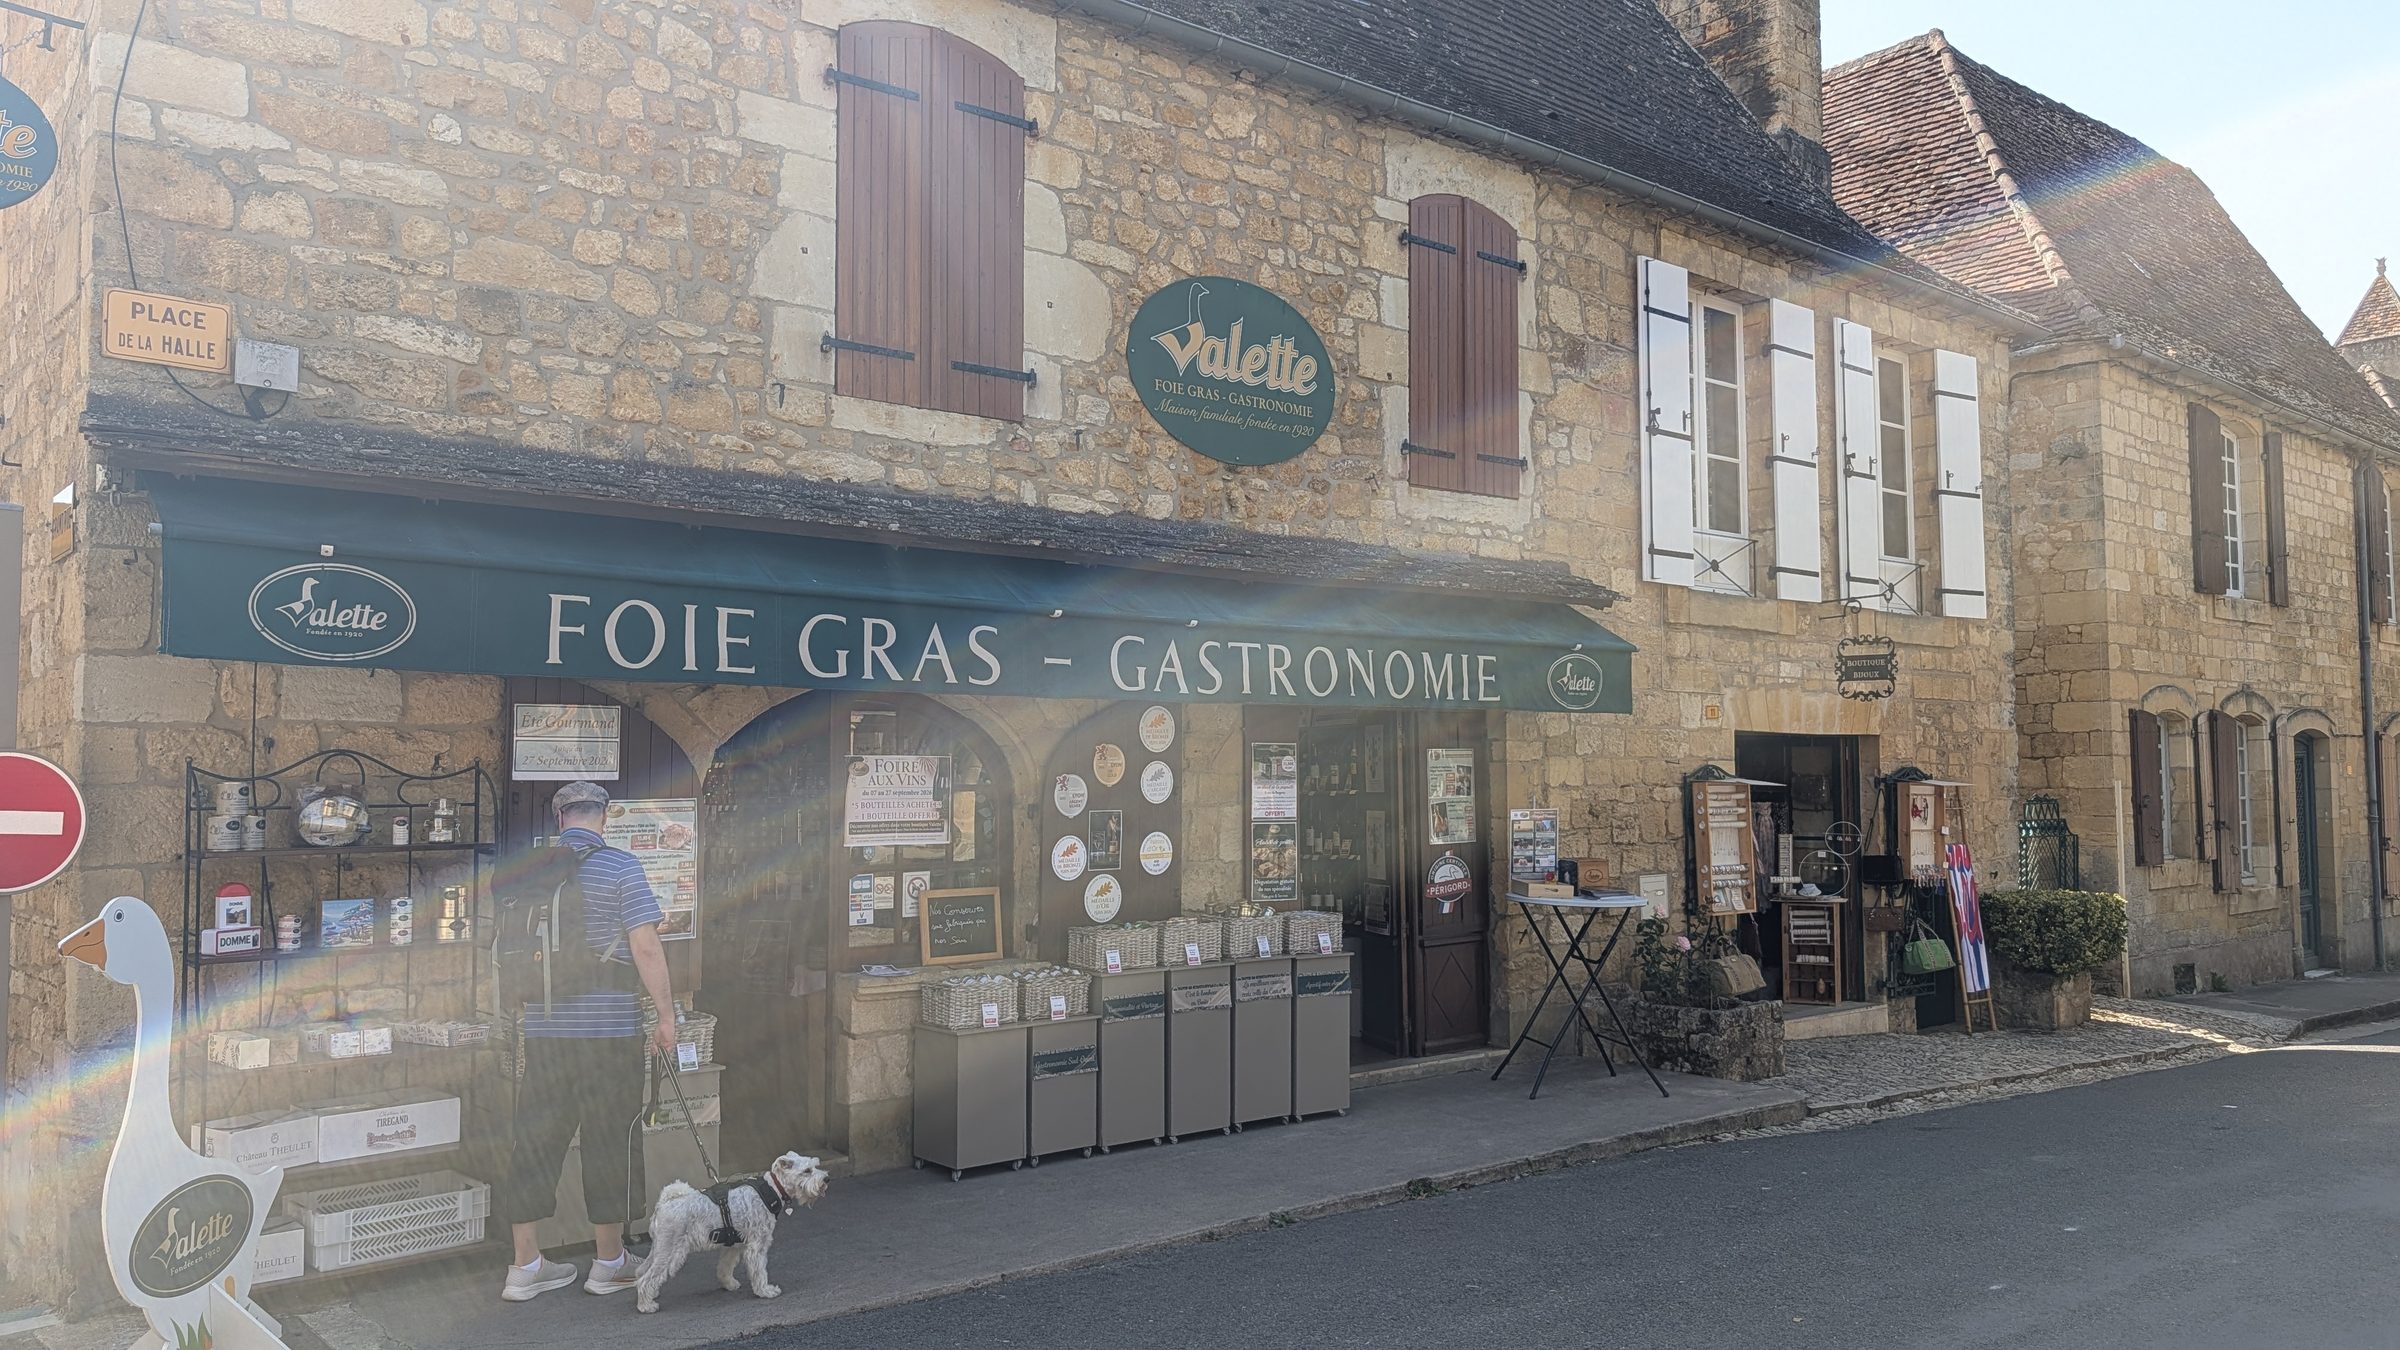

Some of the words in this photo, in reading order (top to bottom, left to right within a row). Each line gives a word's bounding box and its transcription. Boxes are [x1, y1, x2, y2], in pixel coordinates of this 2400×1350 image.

[131, 301, 207, 330] PLACE
[118, 332, 133, 349] DE
[138, 335, 152, 351] LA
[162, 335, 216, 360] HALLE
[1150, 298, 1318, 396] Valette
[1154, 378, 1184, 395] FOIE
[1187, 384, 1220, 401] GRAS
[1228, 391, 1314, 418] GASTRONOMIE
[1154, 398, 1198, 418] Maison
[1195, 406, 1243, 425] familiale
[1242, 413, 1277, 431] fondée
[1279, 424, 1291, 434] en
[1291, 423, 1315, 438] 1920
[275, 589, 388, 631] Valette
[305, 627, 332, 636] Fondée
[344, 630, 363, 638] 1920
[545, 593, 756, 675] FOIE
[799, 613, 1001, 687] GRAS
[1110, 634, 1501, 702] GASTRONOMIE
[1846, 658, 1886, 668] BOUTIQUE
[1556, 668, 1596, 692] Valette
[1852, 670, 1880, 679] BIJOUX
[521, 711, 545, 728] Été
[546, 714, 616, 729] Gourmand
[522, 756, 536, 766] 27
[536, 755, 588, 768] Septembre
[874, 758, 920, 774] FOIRE
[868, 775, 894, 786] AUX
[896, 774, 927, 786] VINS
[892, 789, 919, 798] septembre
[860, 800, 906, 810] BOUTEILLES
[866, 812, 907, 820] BOUTEILLE
[1430, 858, 1445, 880] ORIGINE
[1430, 880, 1468, 895] PÉRIGORD
[929, 902, 942, 917] Nos
[944, 904, 984, 916] Conserves
[220, 934, 252, 947] DOMME
[376, 1114, 409, 1128] TIREGAND
[236, 1151, 268, 1163] Château
[269, 1141, 313, 1156] THEULET
[148, 1207, 234, 1269] Valette
[169, 1261, 195, 1276] Fondée
[204, 1246, 222, 1259] 1920
[254, 1255, 297, 1270] HEULET
